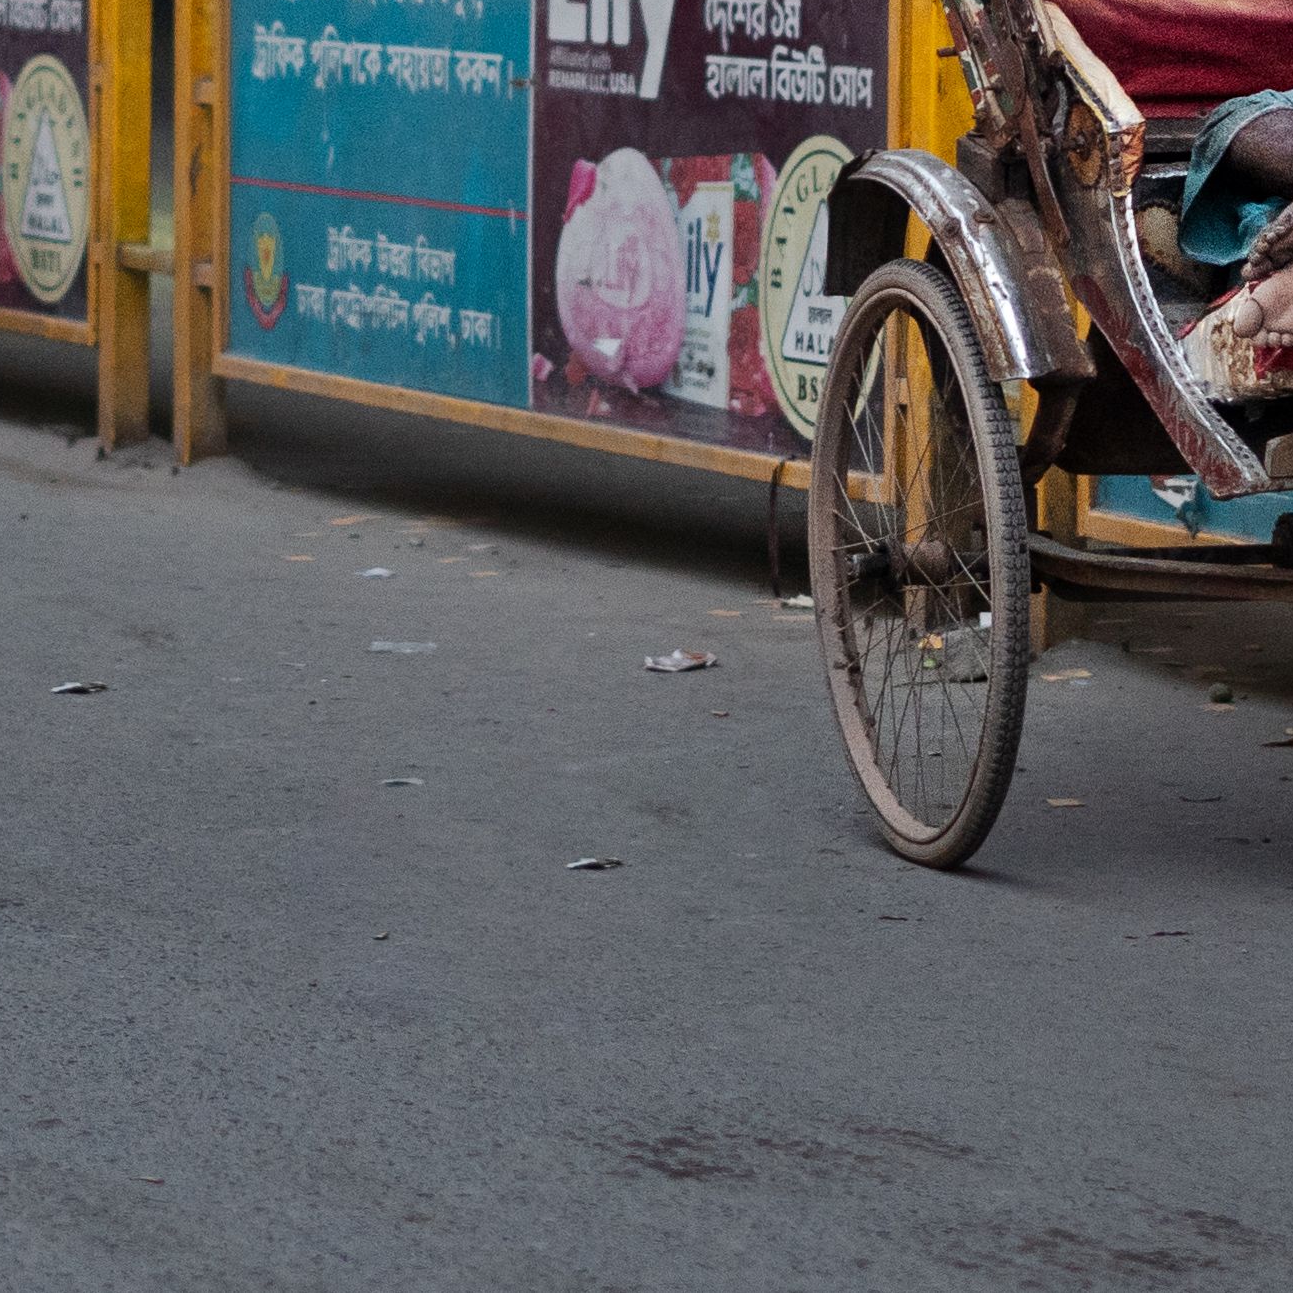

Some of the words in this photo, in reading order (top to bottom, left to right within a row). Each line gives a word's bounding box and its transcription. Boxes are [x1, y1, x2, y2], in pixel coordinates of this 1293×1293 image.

[609, 72, 636, 95] USA
[705, 54, 768, 100] হালাল
[770, 44, 827, 105] বিউটি
[829, 64, 873, 109] সোপ
[686, 217, 724, 318] ily
[795, 332, 835, 356] HAL
